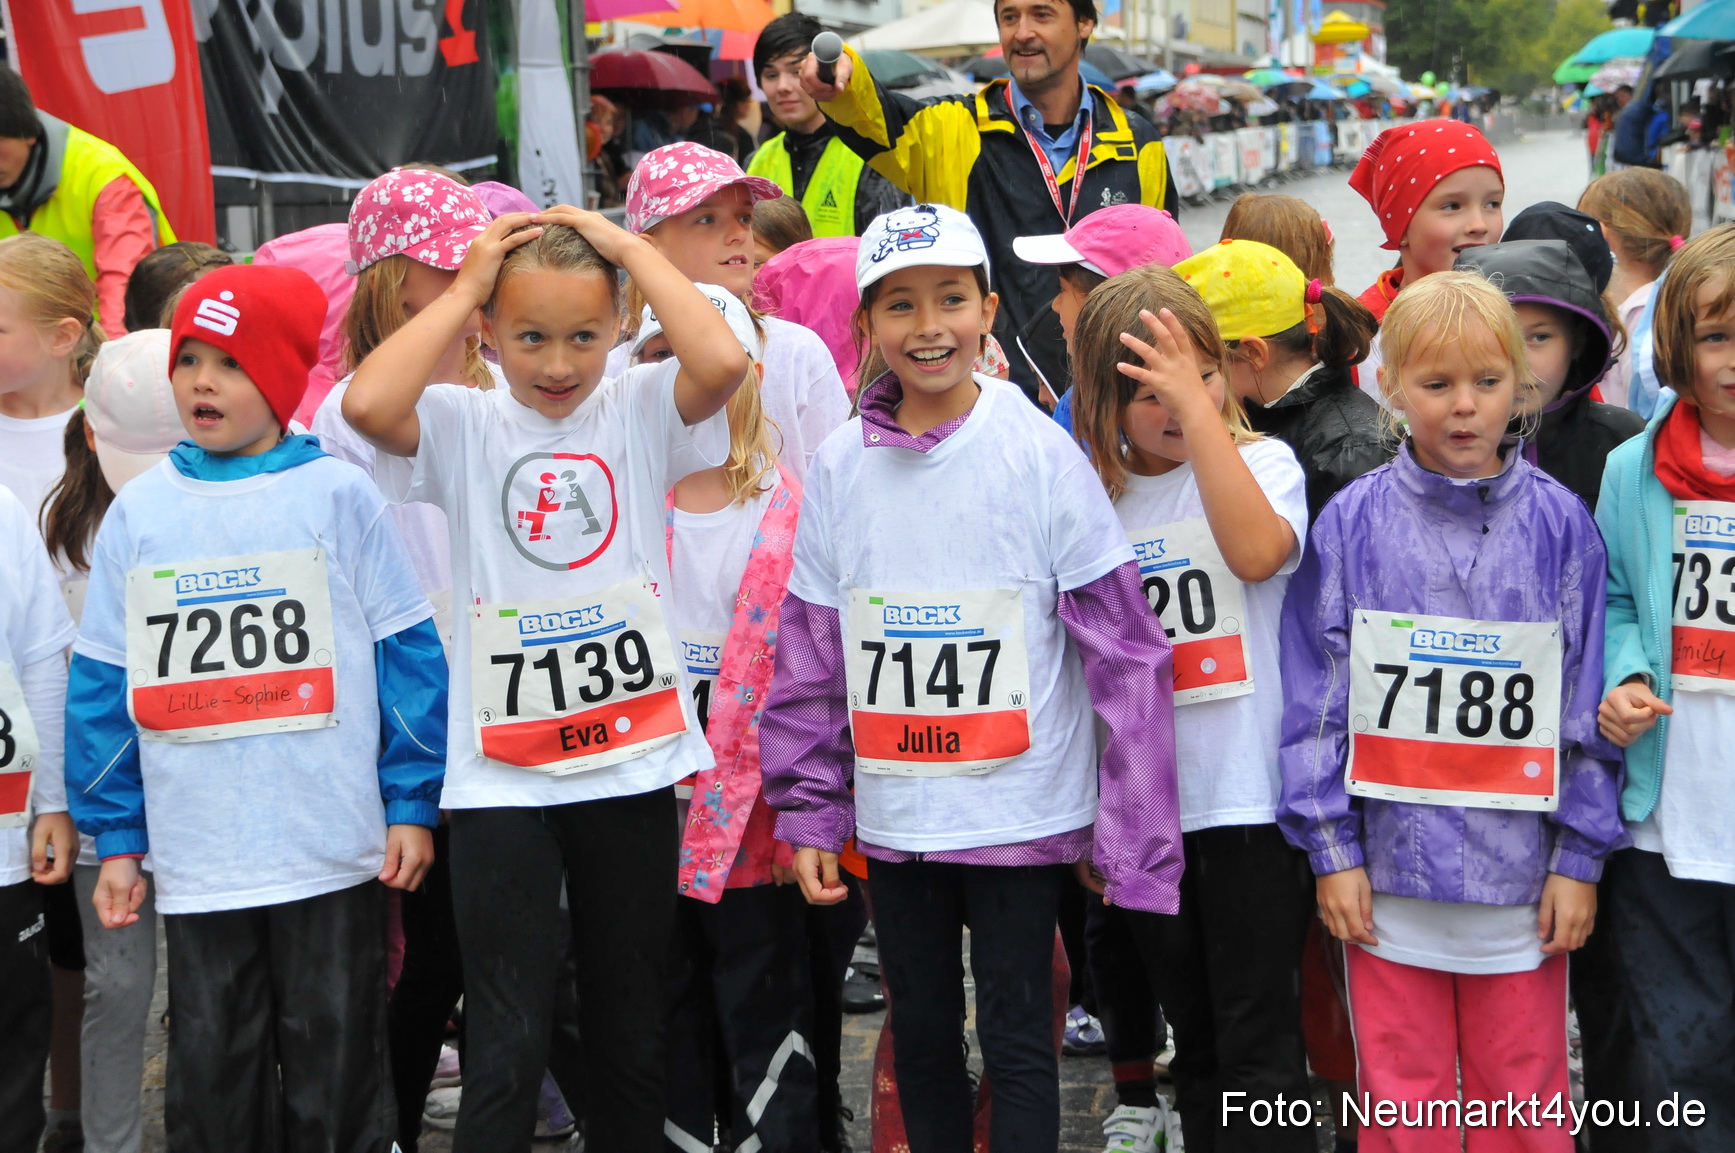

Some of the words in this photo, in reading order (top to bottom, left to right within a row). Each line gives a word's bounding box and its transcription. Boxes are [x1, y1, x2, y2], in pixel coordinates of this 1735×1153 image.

[176, 567, 260, 594] BOCK
[519, 604, 604, 635] BOCK
[884, 605, 961, 625] BOCK
[146, 599, 310, 678] 7268
[681, 641, 720, 663] CK
[1410, 629, 1501, 654] BOCK
[490, 629, 655, 716] 7139
[661, 675, 673, 686] W
[861, 639, 1001, 708] 7147
[1011, 693, 1023, 706] W
[1373, 663, 1534, 740] 7188
[484, 711, 491, 722] 3
[559, 722, 609, 751] Eva
[897, 725, 961, 753] Julia
